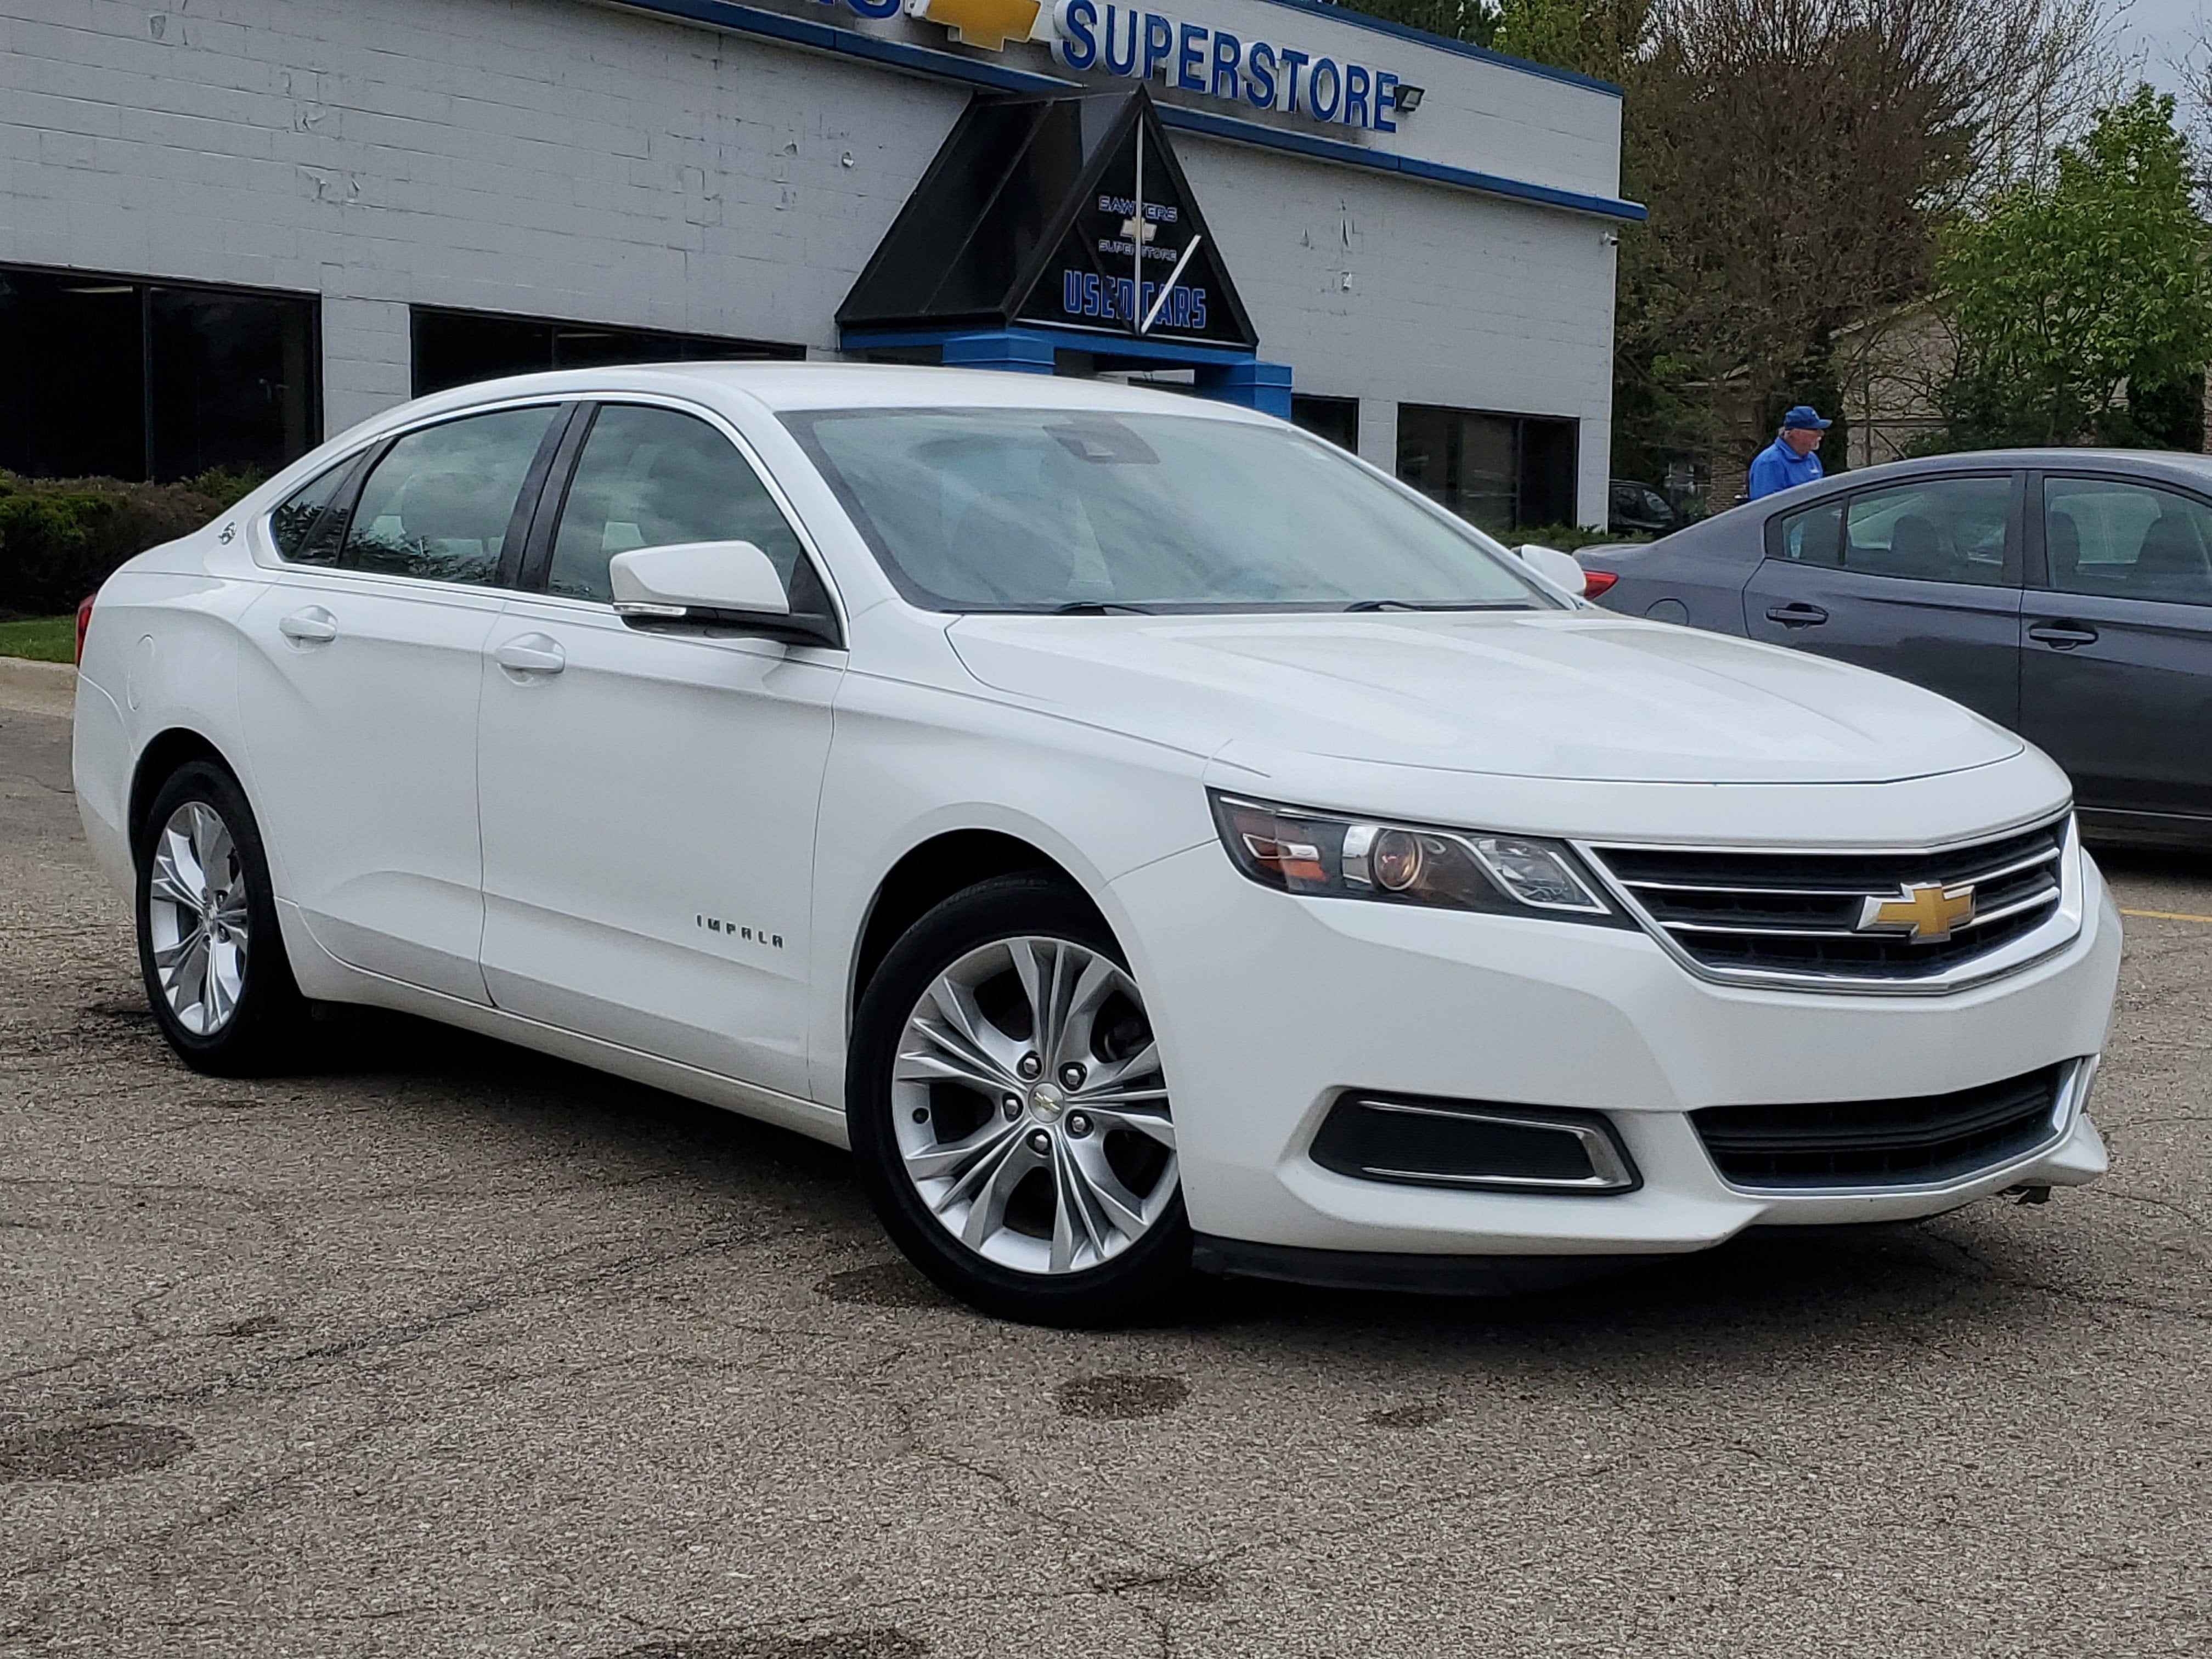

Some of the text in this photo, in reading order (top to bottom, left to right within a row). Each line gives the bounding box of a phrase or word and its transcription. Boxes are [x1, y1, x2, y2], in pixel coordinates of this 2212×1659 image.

[1061, 0, 1398, 133] SUPERSTORE
[1063, 269, 1206, 329] USED CARS
[696, 915, 783, 949] IMPALA
